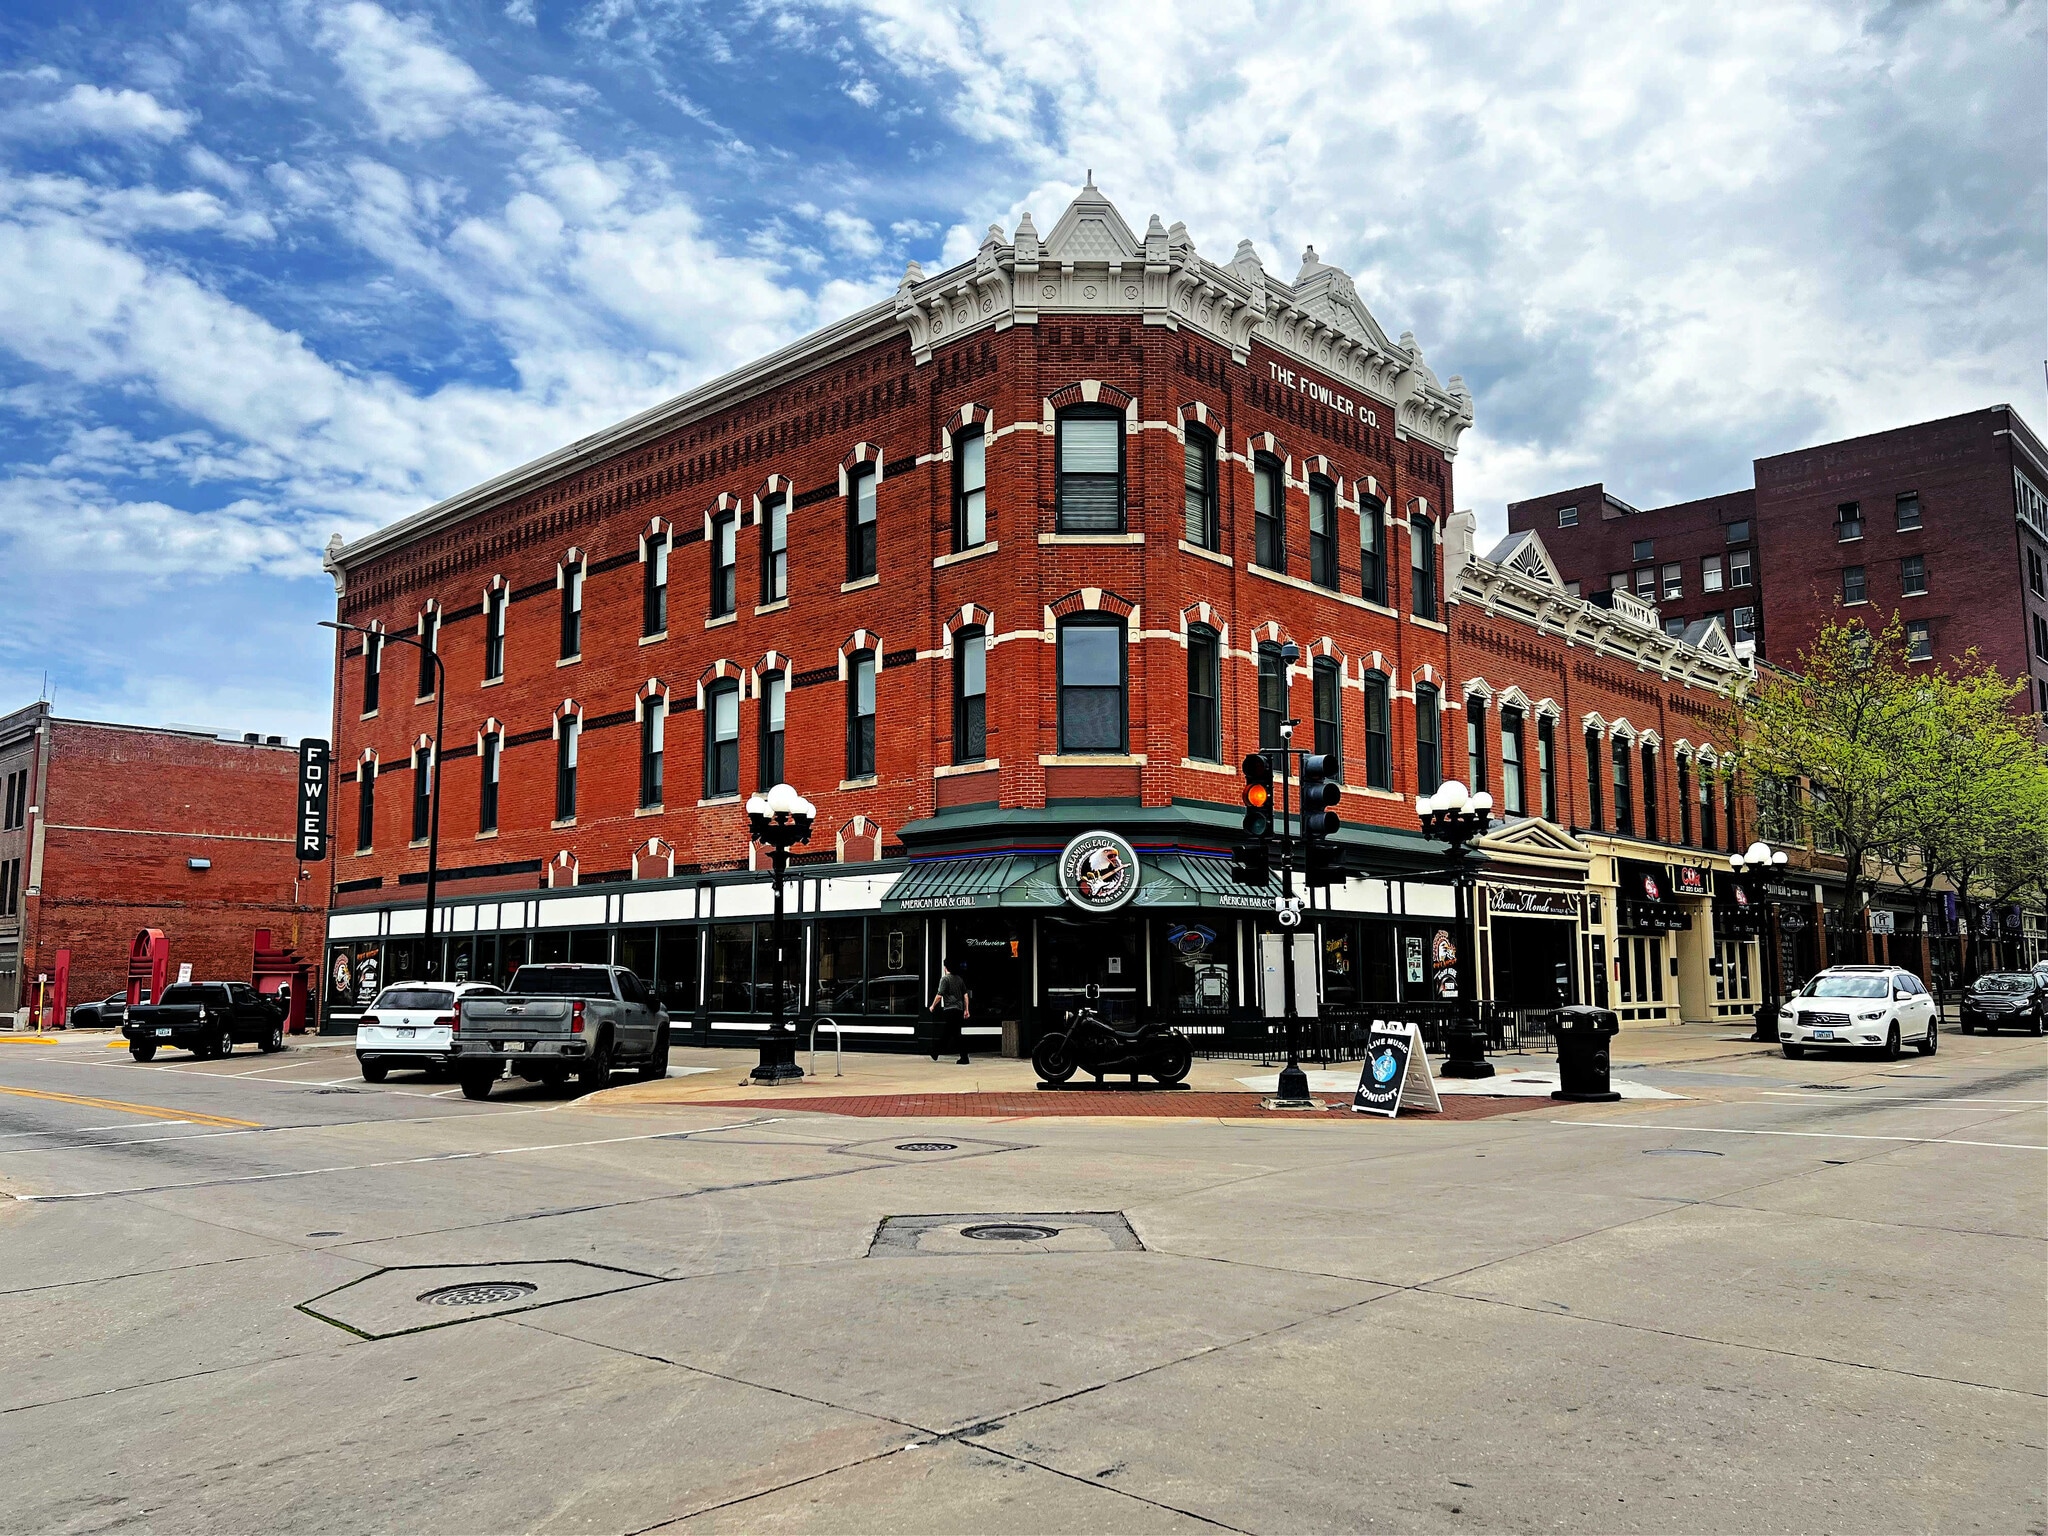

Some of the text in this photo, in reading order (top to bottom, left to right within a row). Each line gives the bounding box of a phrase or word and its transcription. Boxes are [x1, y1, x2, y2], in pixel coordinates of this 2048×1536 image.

[1268, 361, 1380, 429] THE FOWLER CO.
[304, 748, 322, 850] FOWLER
[1067, 839, 1116, 877] SCREAMING EAGLE
[900, 896, 976, 910] AMERICAN BAR & GRILL
[1219, 894, 1249, 906] AMERICAN
[1249, 897, 1261, 907] BAR
[1261, 898, 1268, 907] &
[1491, 889, 1516, 910] Beau
[1516, 894, 1551, 912] Monde
[1369, 1038, 1408, 1053] LIVE MUSIC
[1358, 1083, 1398, 1103] TONIGHT
